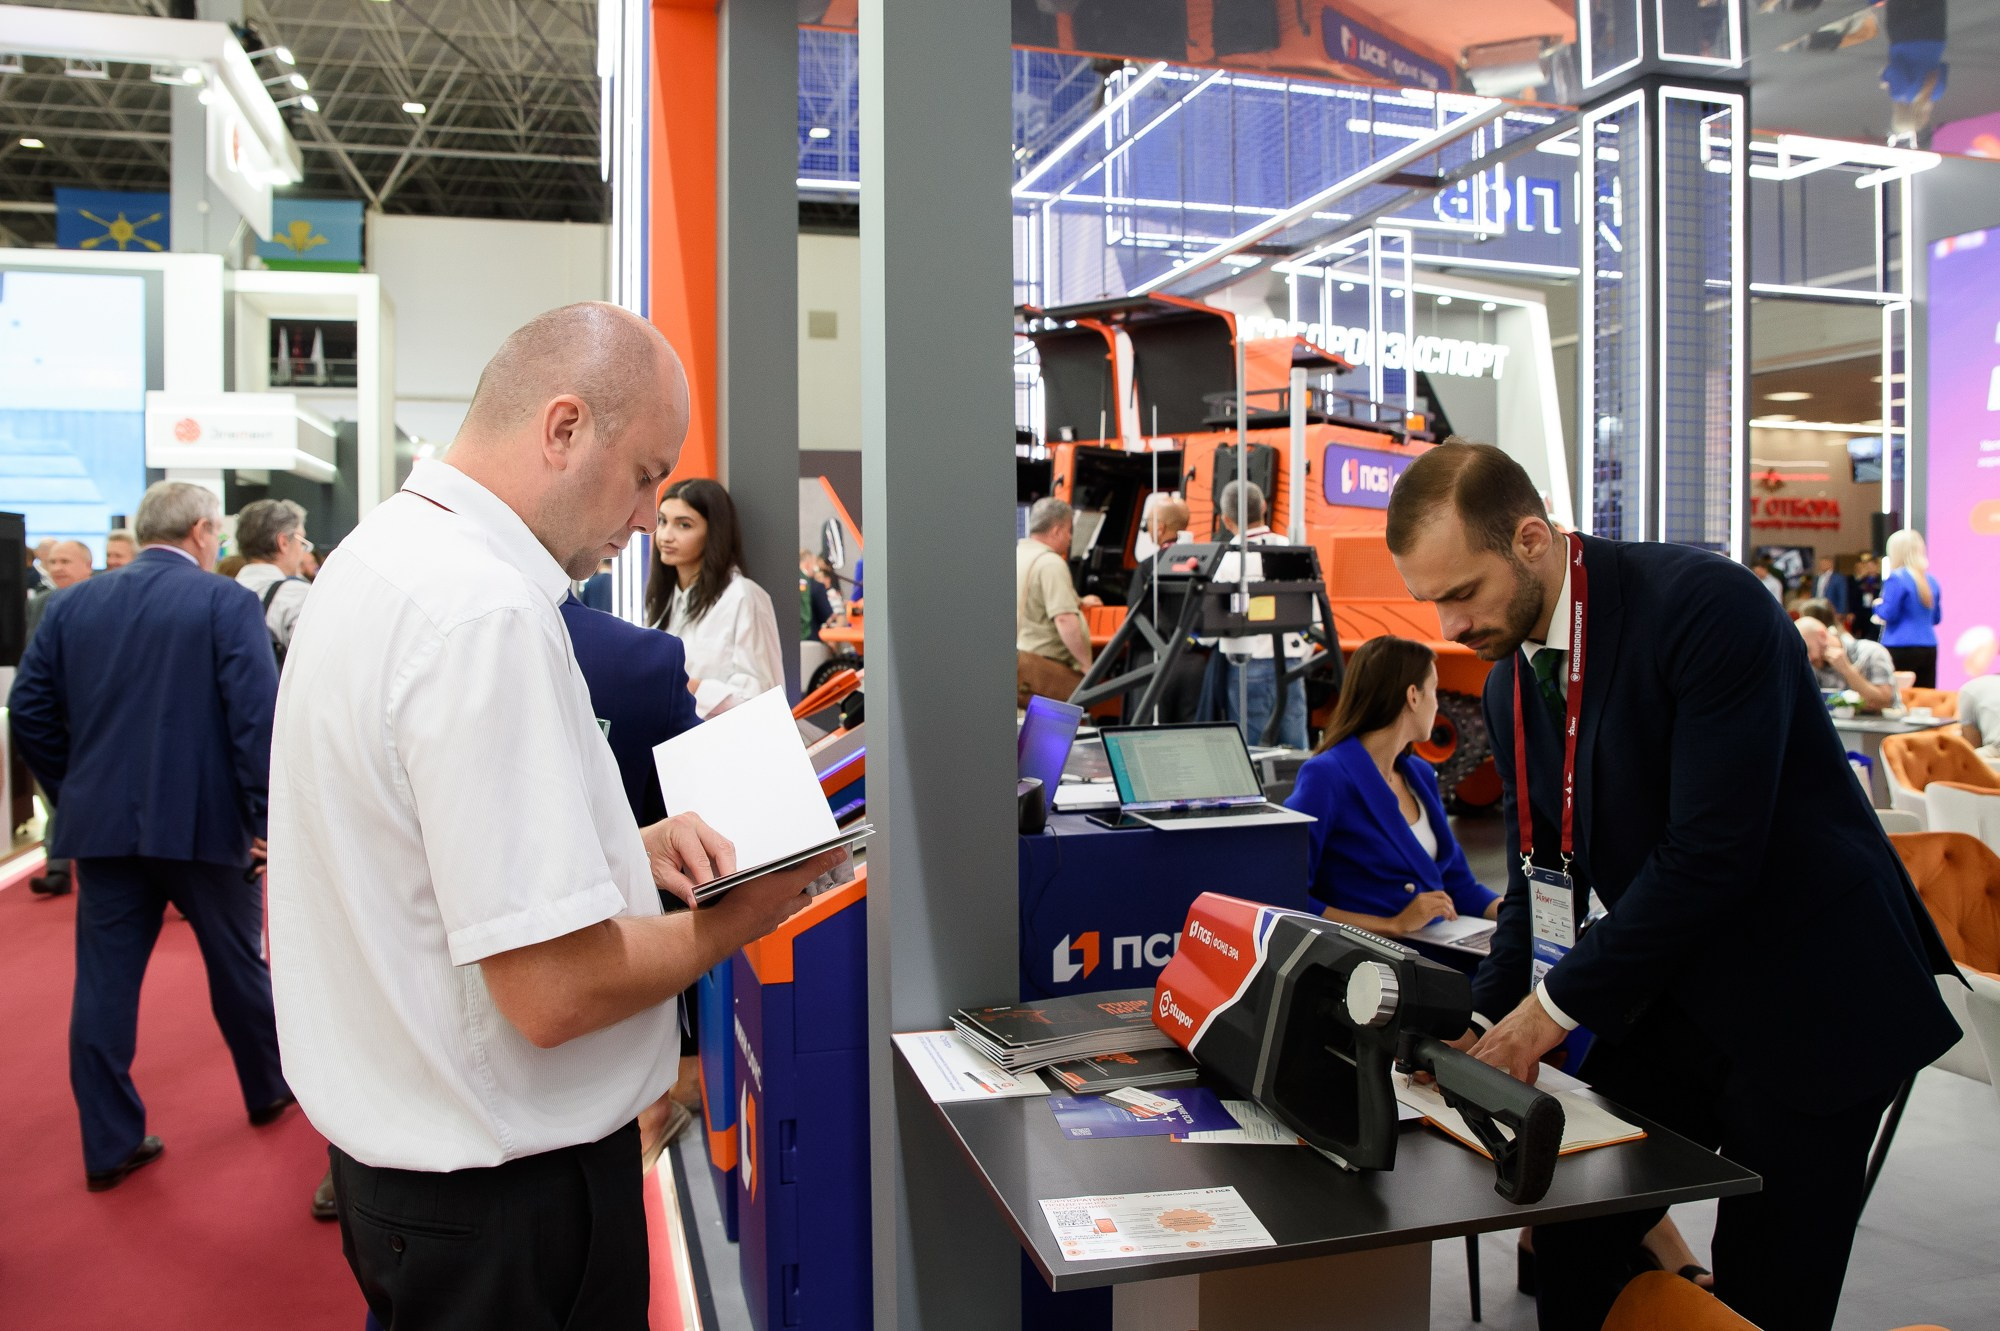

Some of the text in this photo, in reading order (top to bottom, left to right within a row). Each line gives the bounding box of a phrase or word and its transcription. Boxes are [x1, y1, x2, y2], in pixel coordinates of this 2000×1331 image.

[1360, 464, 1389, 493] ПСБ
[1765, 497, 1840, 517] ОТБОРА
[1573, 601, 1583, 673] ROSOBORONEXPORT
[1113, 932, 1182, 970] ПС
[1196, 925, 1239, 961] ПСБ ФОНД ЭРА
[1168, 1002, 1194, 1029] stupor
